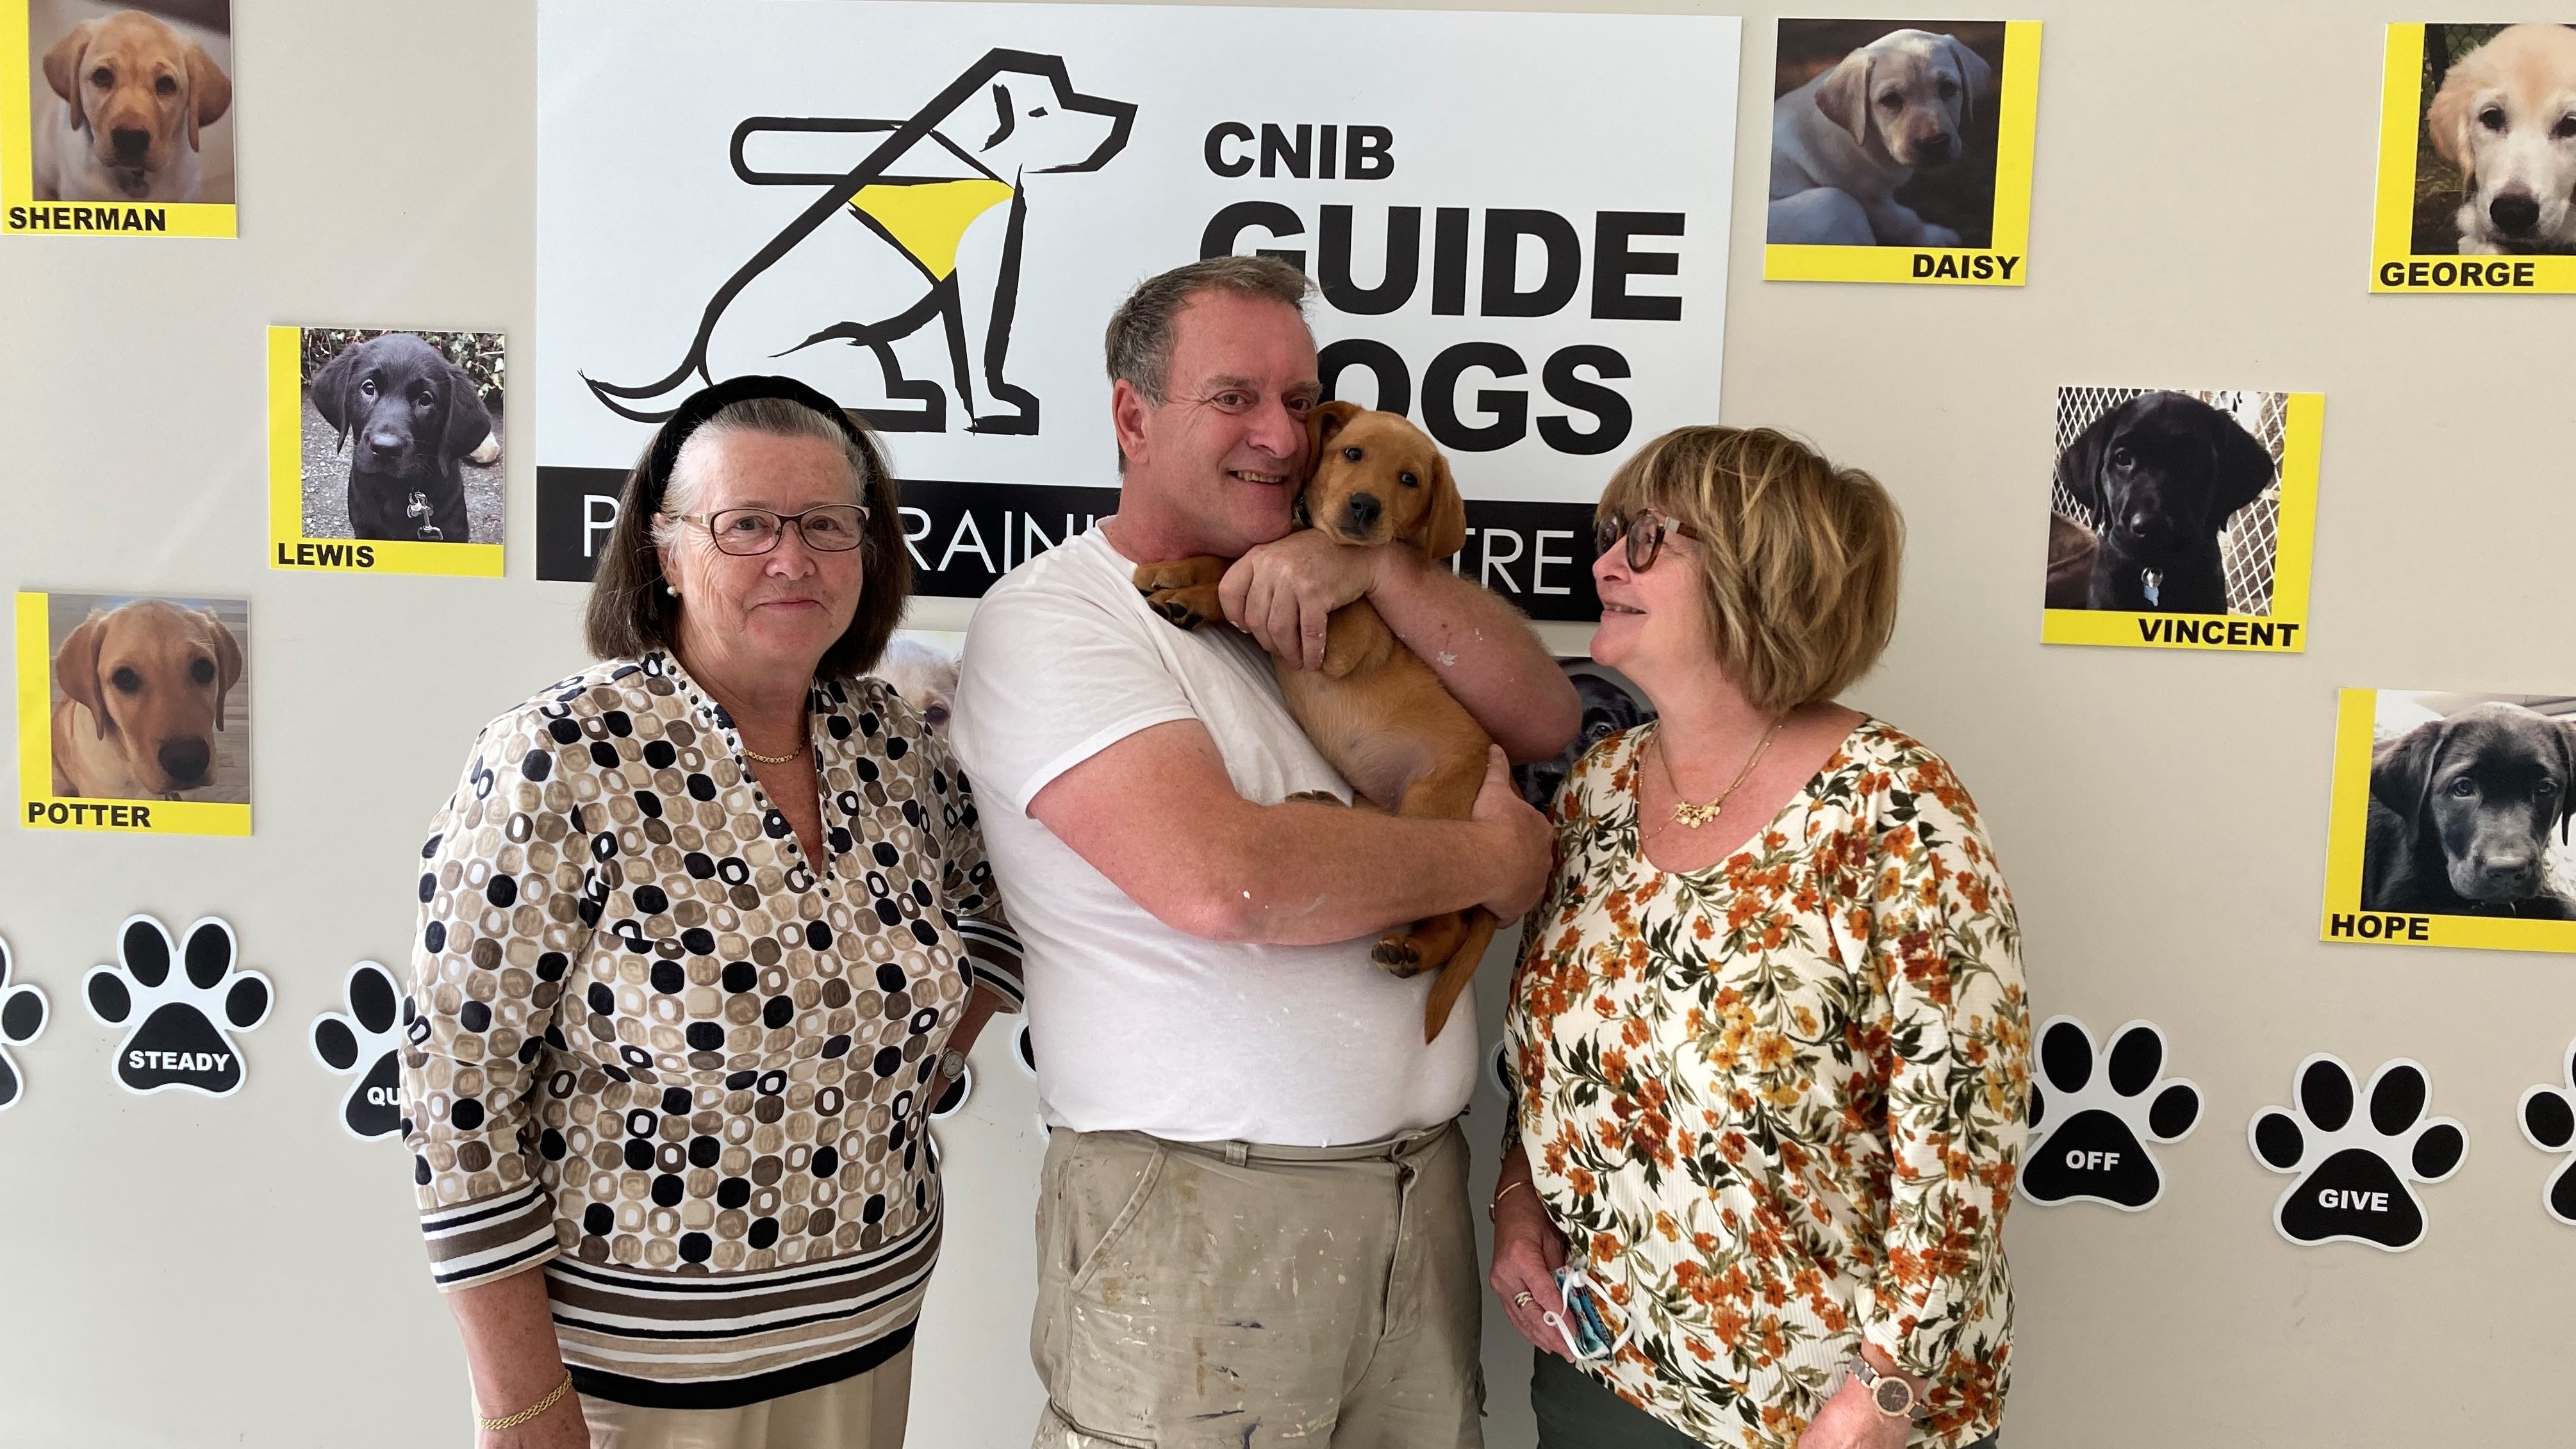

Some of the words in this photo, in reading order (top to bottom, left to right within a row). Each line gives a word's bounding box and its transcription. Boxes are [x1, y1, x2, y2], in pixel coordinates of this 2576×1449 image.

[1204, 121, 1394, 181] CNIB
[9, 206, 167, 232] SHERMAN
[1912, 253, 2021, 280] DAISY
[2379, 261, 2536, 288] GEORGE
[1316, 338, 1631, 455] OGS
[278, 543, 375, 568] LEWIS
[898, 507, 1094, 574] RAIN
[1452, 527, 1574, 595] TRE
[2138, 618, 2300, 647] VINCENT
[28, 801, 152, 829] POTTER
[2331, 913, 2431, 942] HOPE
[129, 1050, 230, 1072] STEADY
[367, 1086, 400, 1107] QU
[2066, 1150, 2120, 1171] OFF
[2318, 1188, 2389, 1212] GIVE
